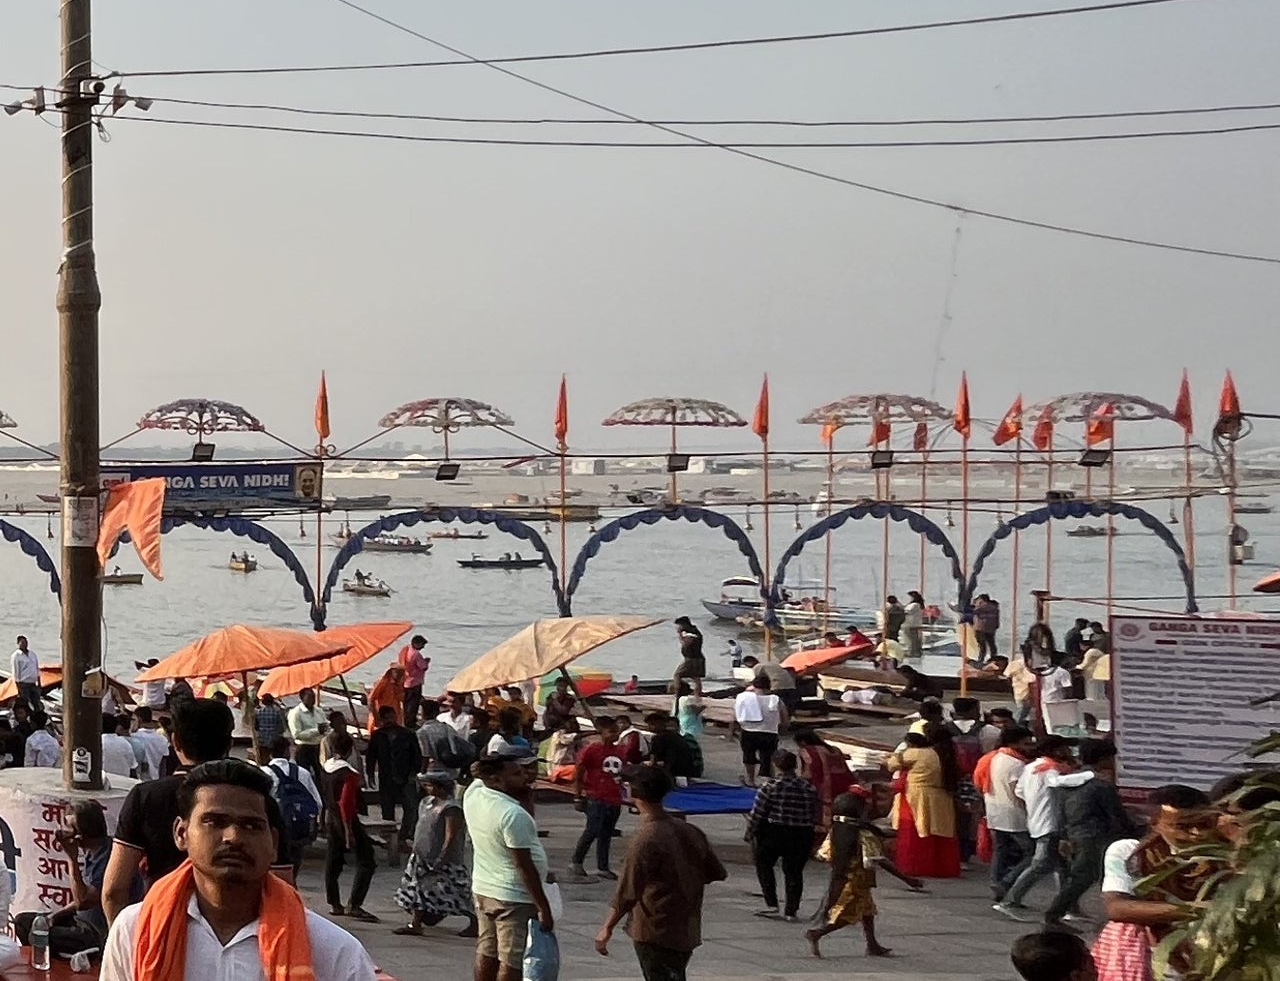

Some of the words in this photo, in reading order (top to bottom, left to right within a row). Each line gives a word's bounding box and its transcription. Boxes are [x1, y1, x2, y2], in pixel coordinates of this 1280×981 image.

[199, 475, 239, 488] SEVA
[1148, 622, 1198, 633] GANGA
[1203, 624, 1241, 634] SEVA
